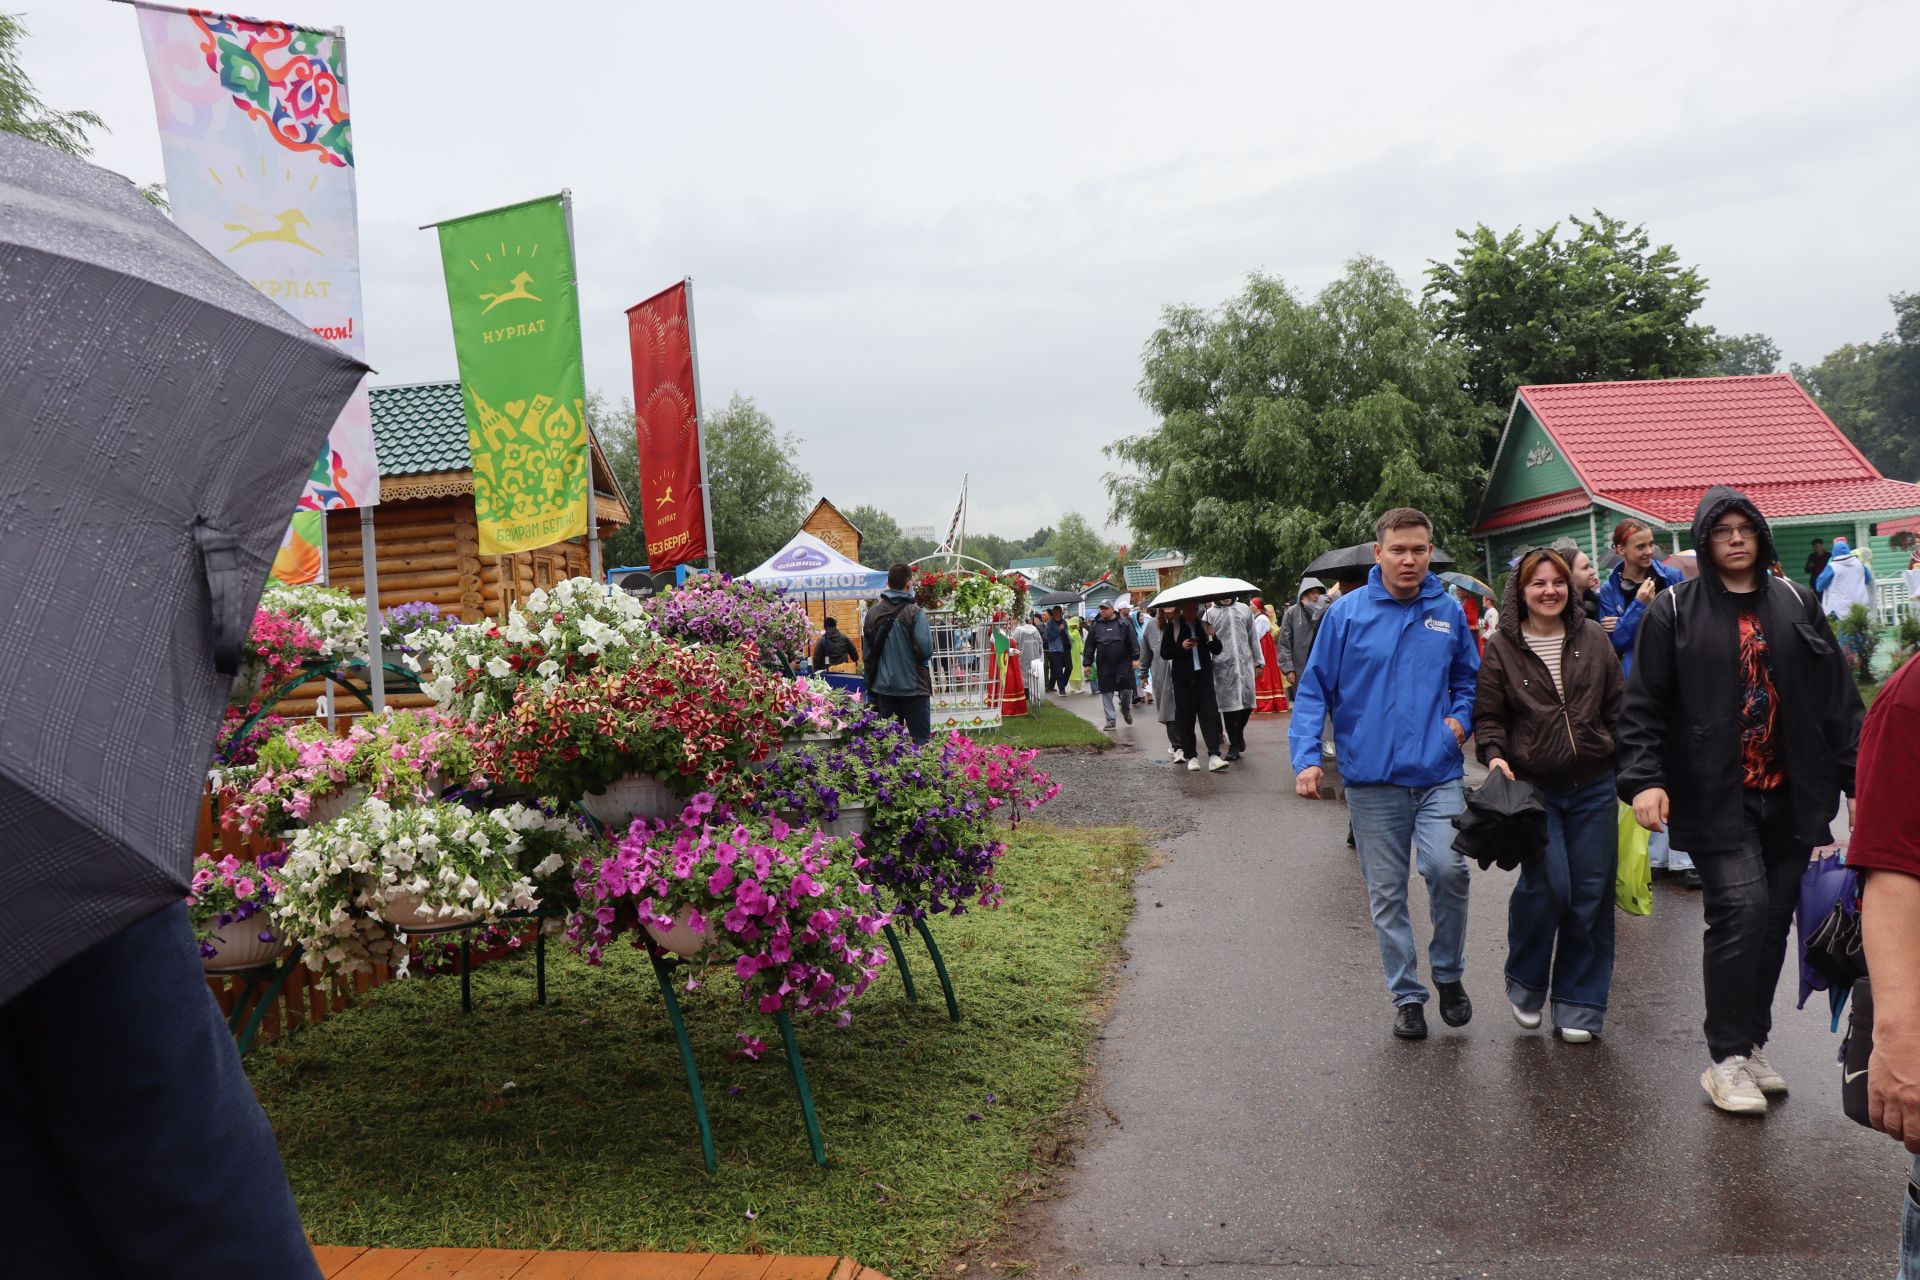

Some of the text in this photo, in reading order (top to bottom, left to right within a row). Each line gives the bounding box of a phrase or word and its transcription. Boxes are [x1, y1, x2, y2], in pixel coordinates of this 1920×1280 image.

[250, 280, 332, 298] УРЛАТ
[309, 317, 353, 340] ком!
[482, 319, 545, 344] НУРЛАТ
[657, 512, 677, 527] НУРЛАТ
[648, 541, 664, 556] БЕЗ
[760, 573, 867, 590] РОЖЕНОЕ
